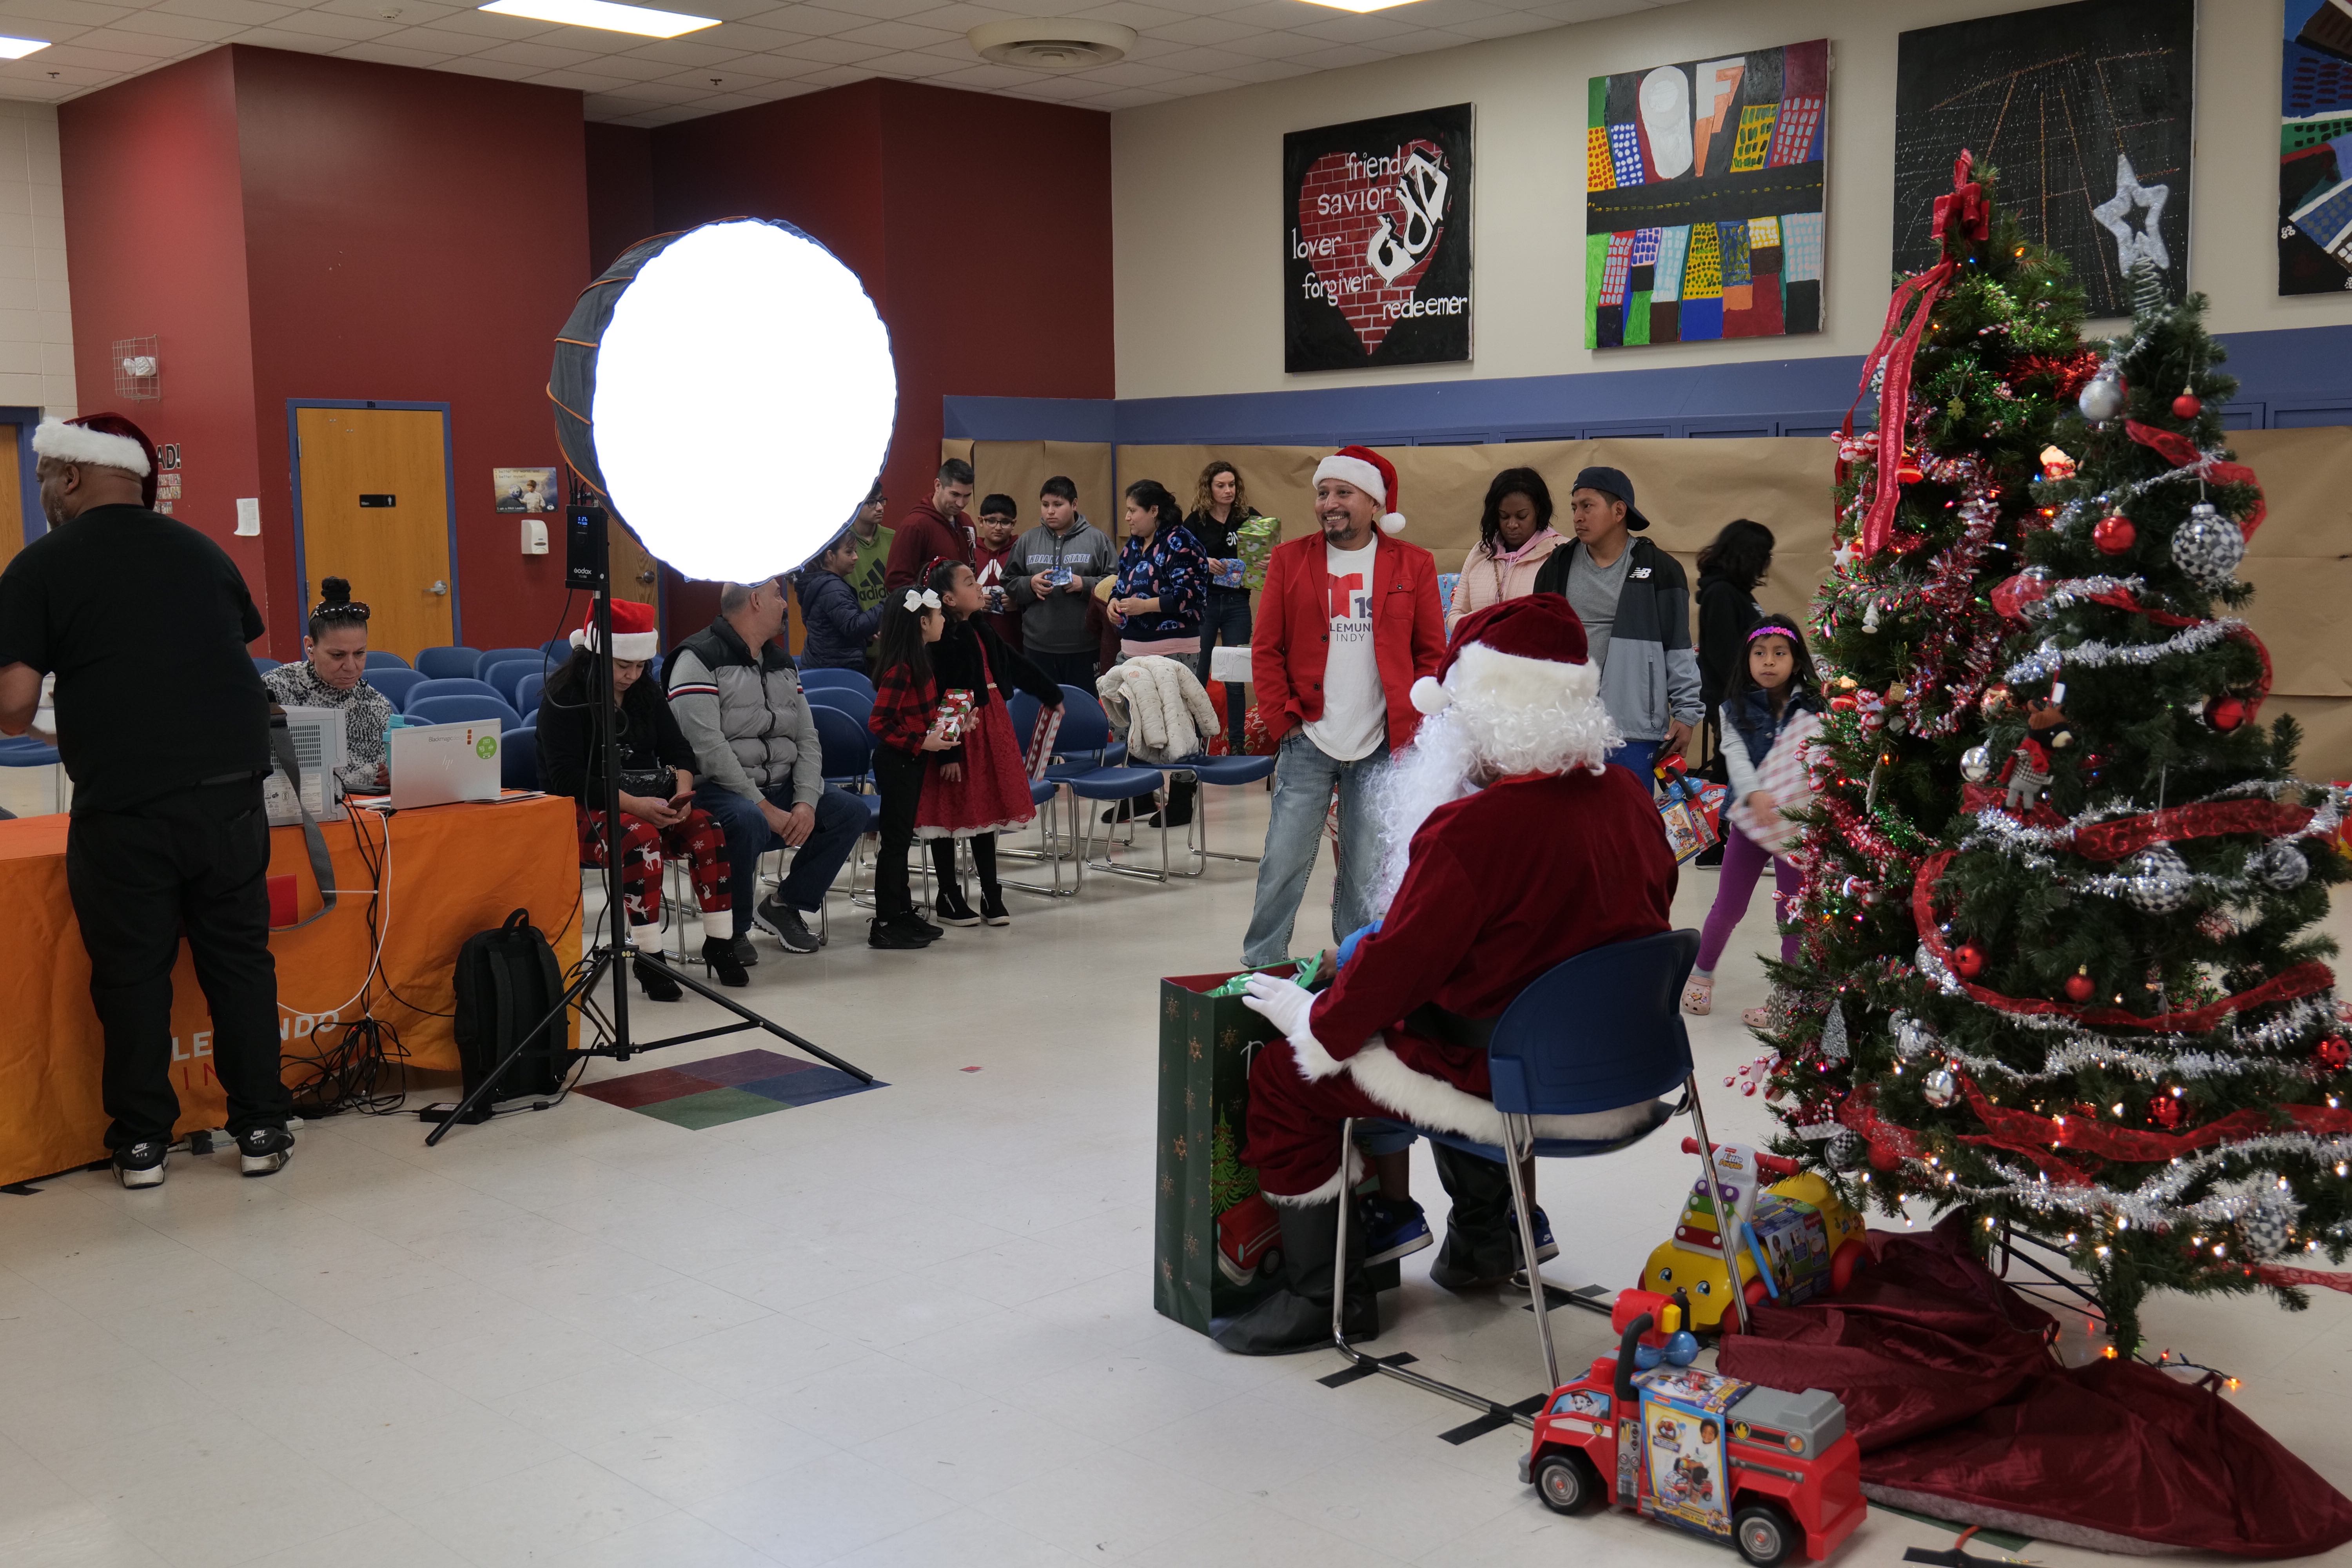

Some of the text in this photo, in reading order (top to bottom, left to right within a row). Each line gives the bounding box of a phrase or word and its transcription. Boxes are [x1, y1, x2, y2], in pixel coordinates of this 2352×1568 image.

[1346, 145, 1401, 181] friend
[1318, 186, 1392, 215] savior
[1291, 228, 1341, 260] lover
[1302, 272, 1373, 307] forgiver
[1382, 292, 1468, 320] redeemer
[1063, 553, 1091, 564] STATE
[858, 584, 890, 601] adid
[1330, 622, 1374, 632] LEMUN
[1337, 633, 1365, 642] INDY
[1718, 1158, 1743, 1170] People
[1723, 1153, 1743, 1163] Little
